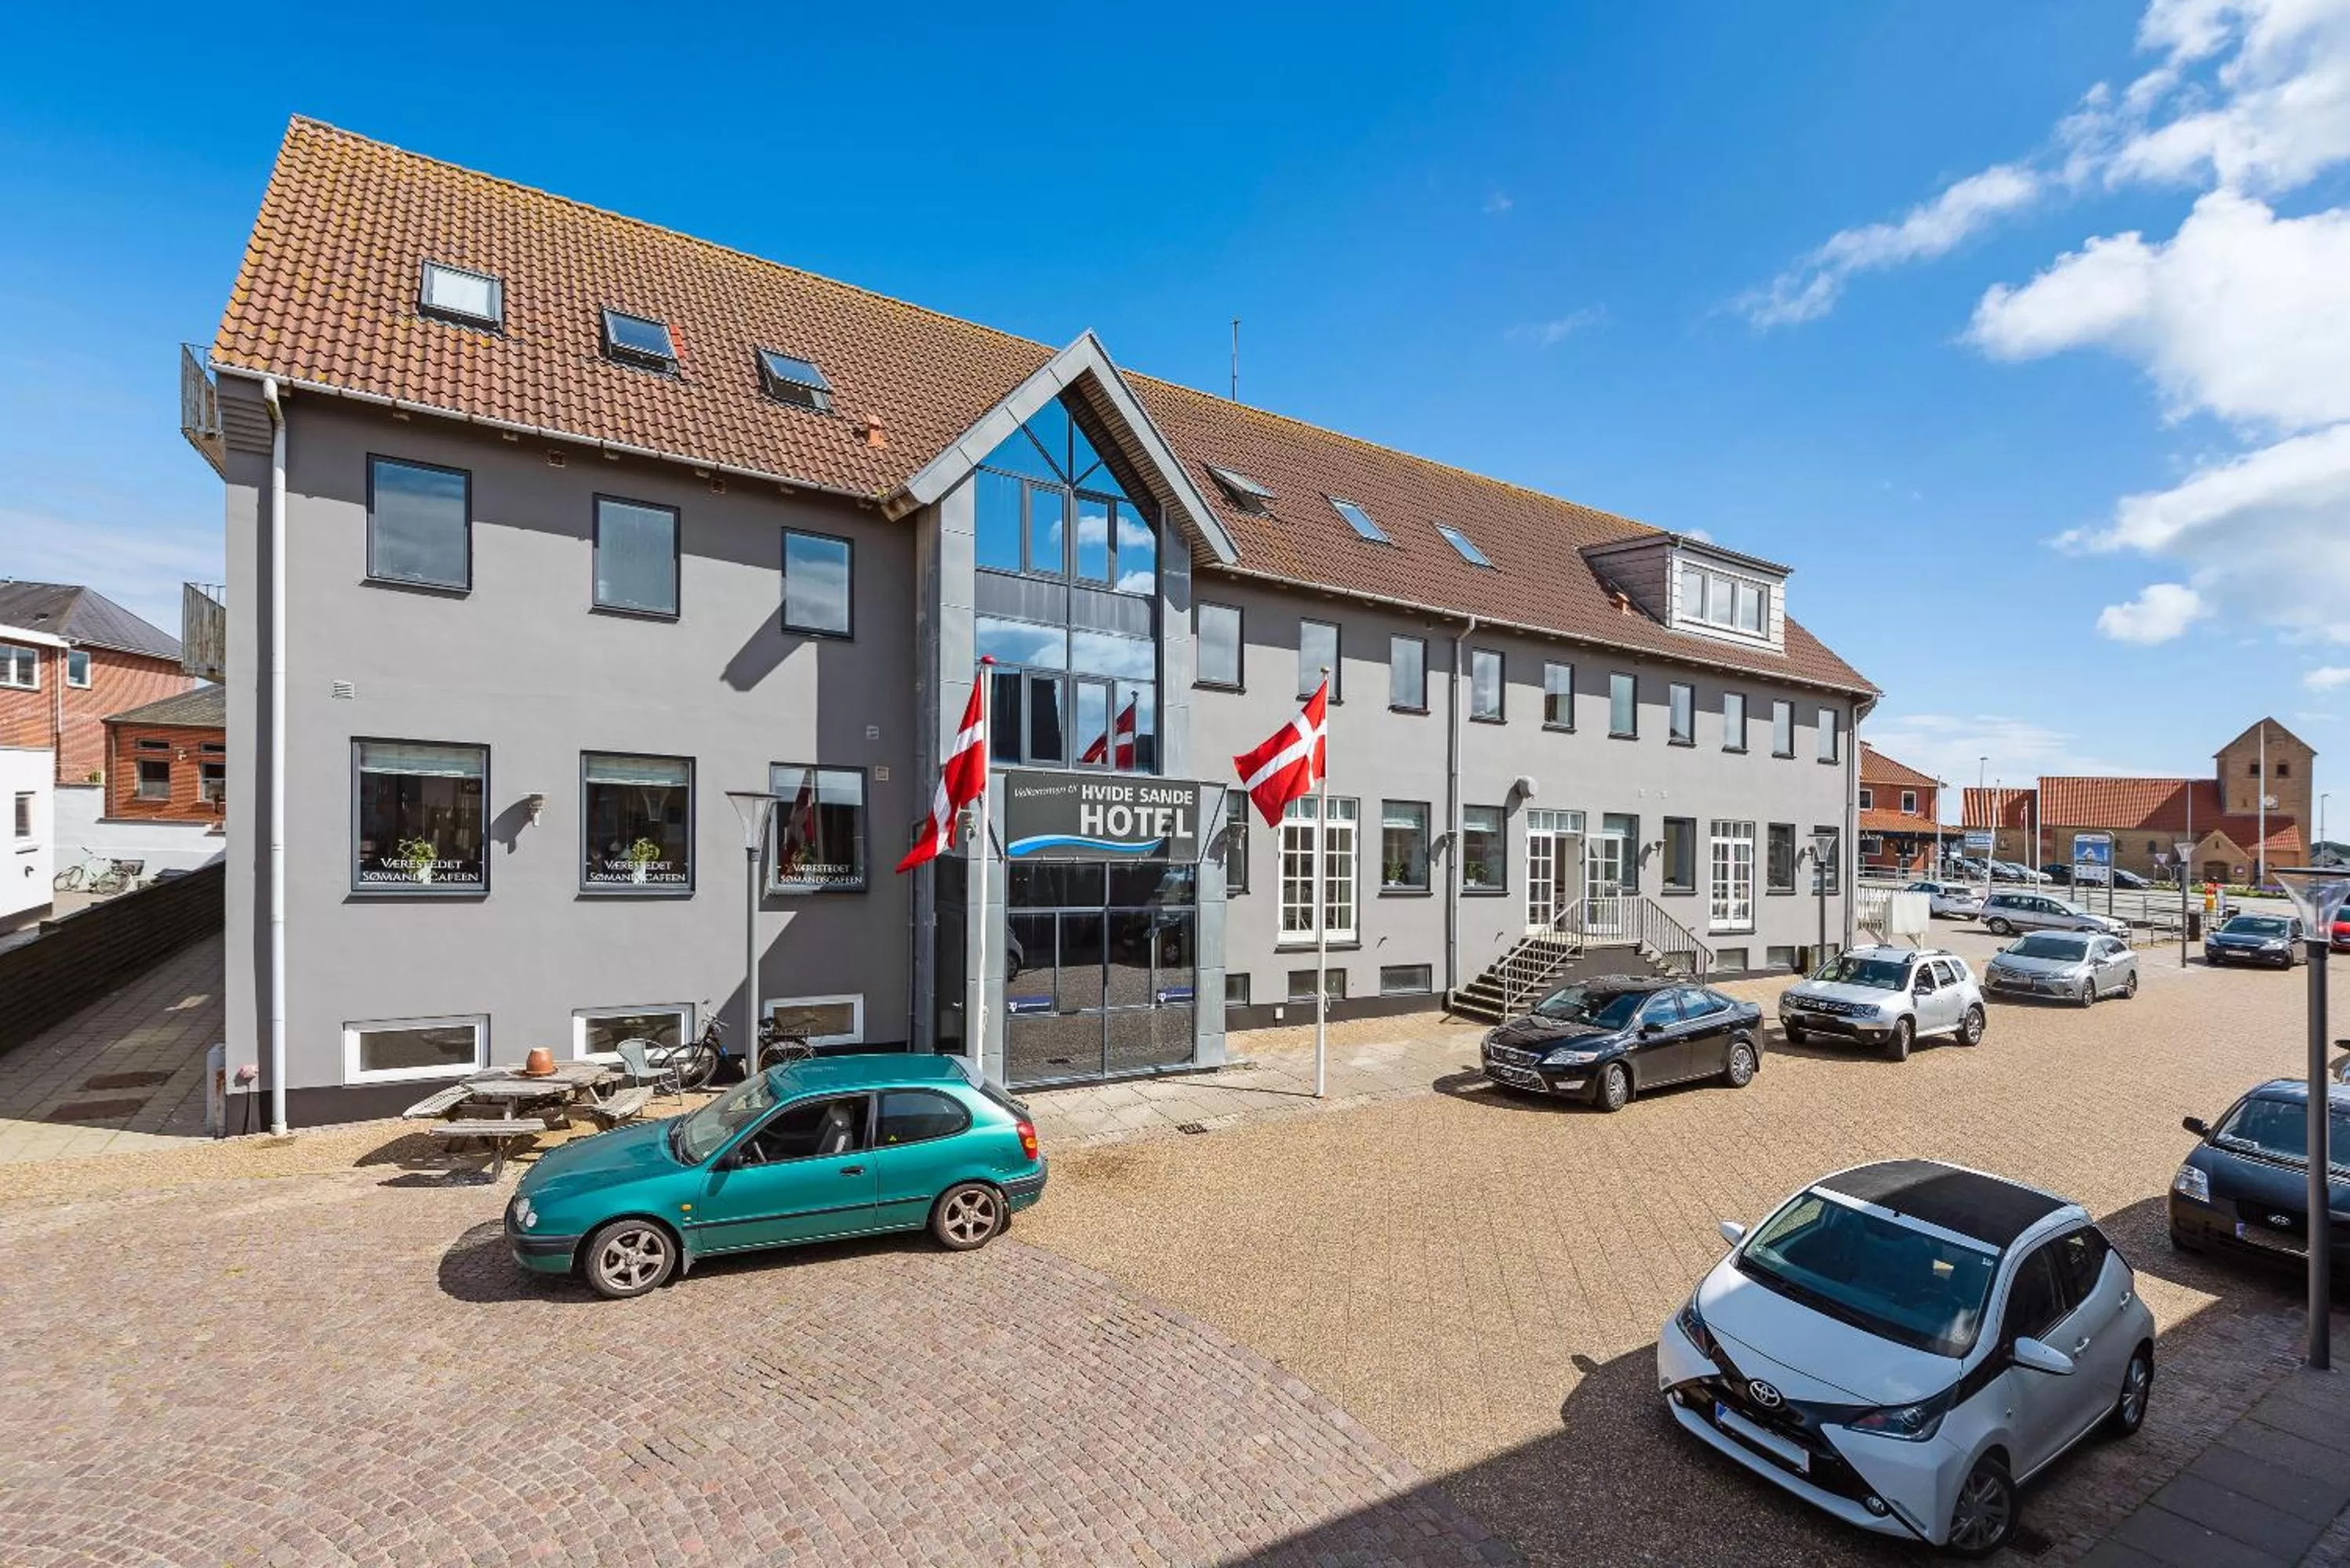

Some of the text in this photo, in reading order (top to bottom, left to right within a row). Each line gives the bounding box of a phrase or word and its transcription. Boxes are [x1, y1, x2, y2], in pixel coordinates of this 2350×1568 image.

[1082, 785, 1134, 802] HVIDE
[1139, 787, 1193, 804] SANDE
[1080, 804, 1193, 838] HOTEL
[590, 872, 686, 882] SØMANDCAFEEN
